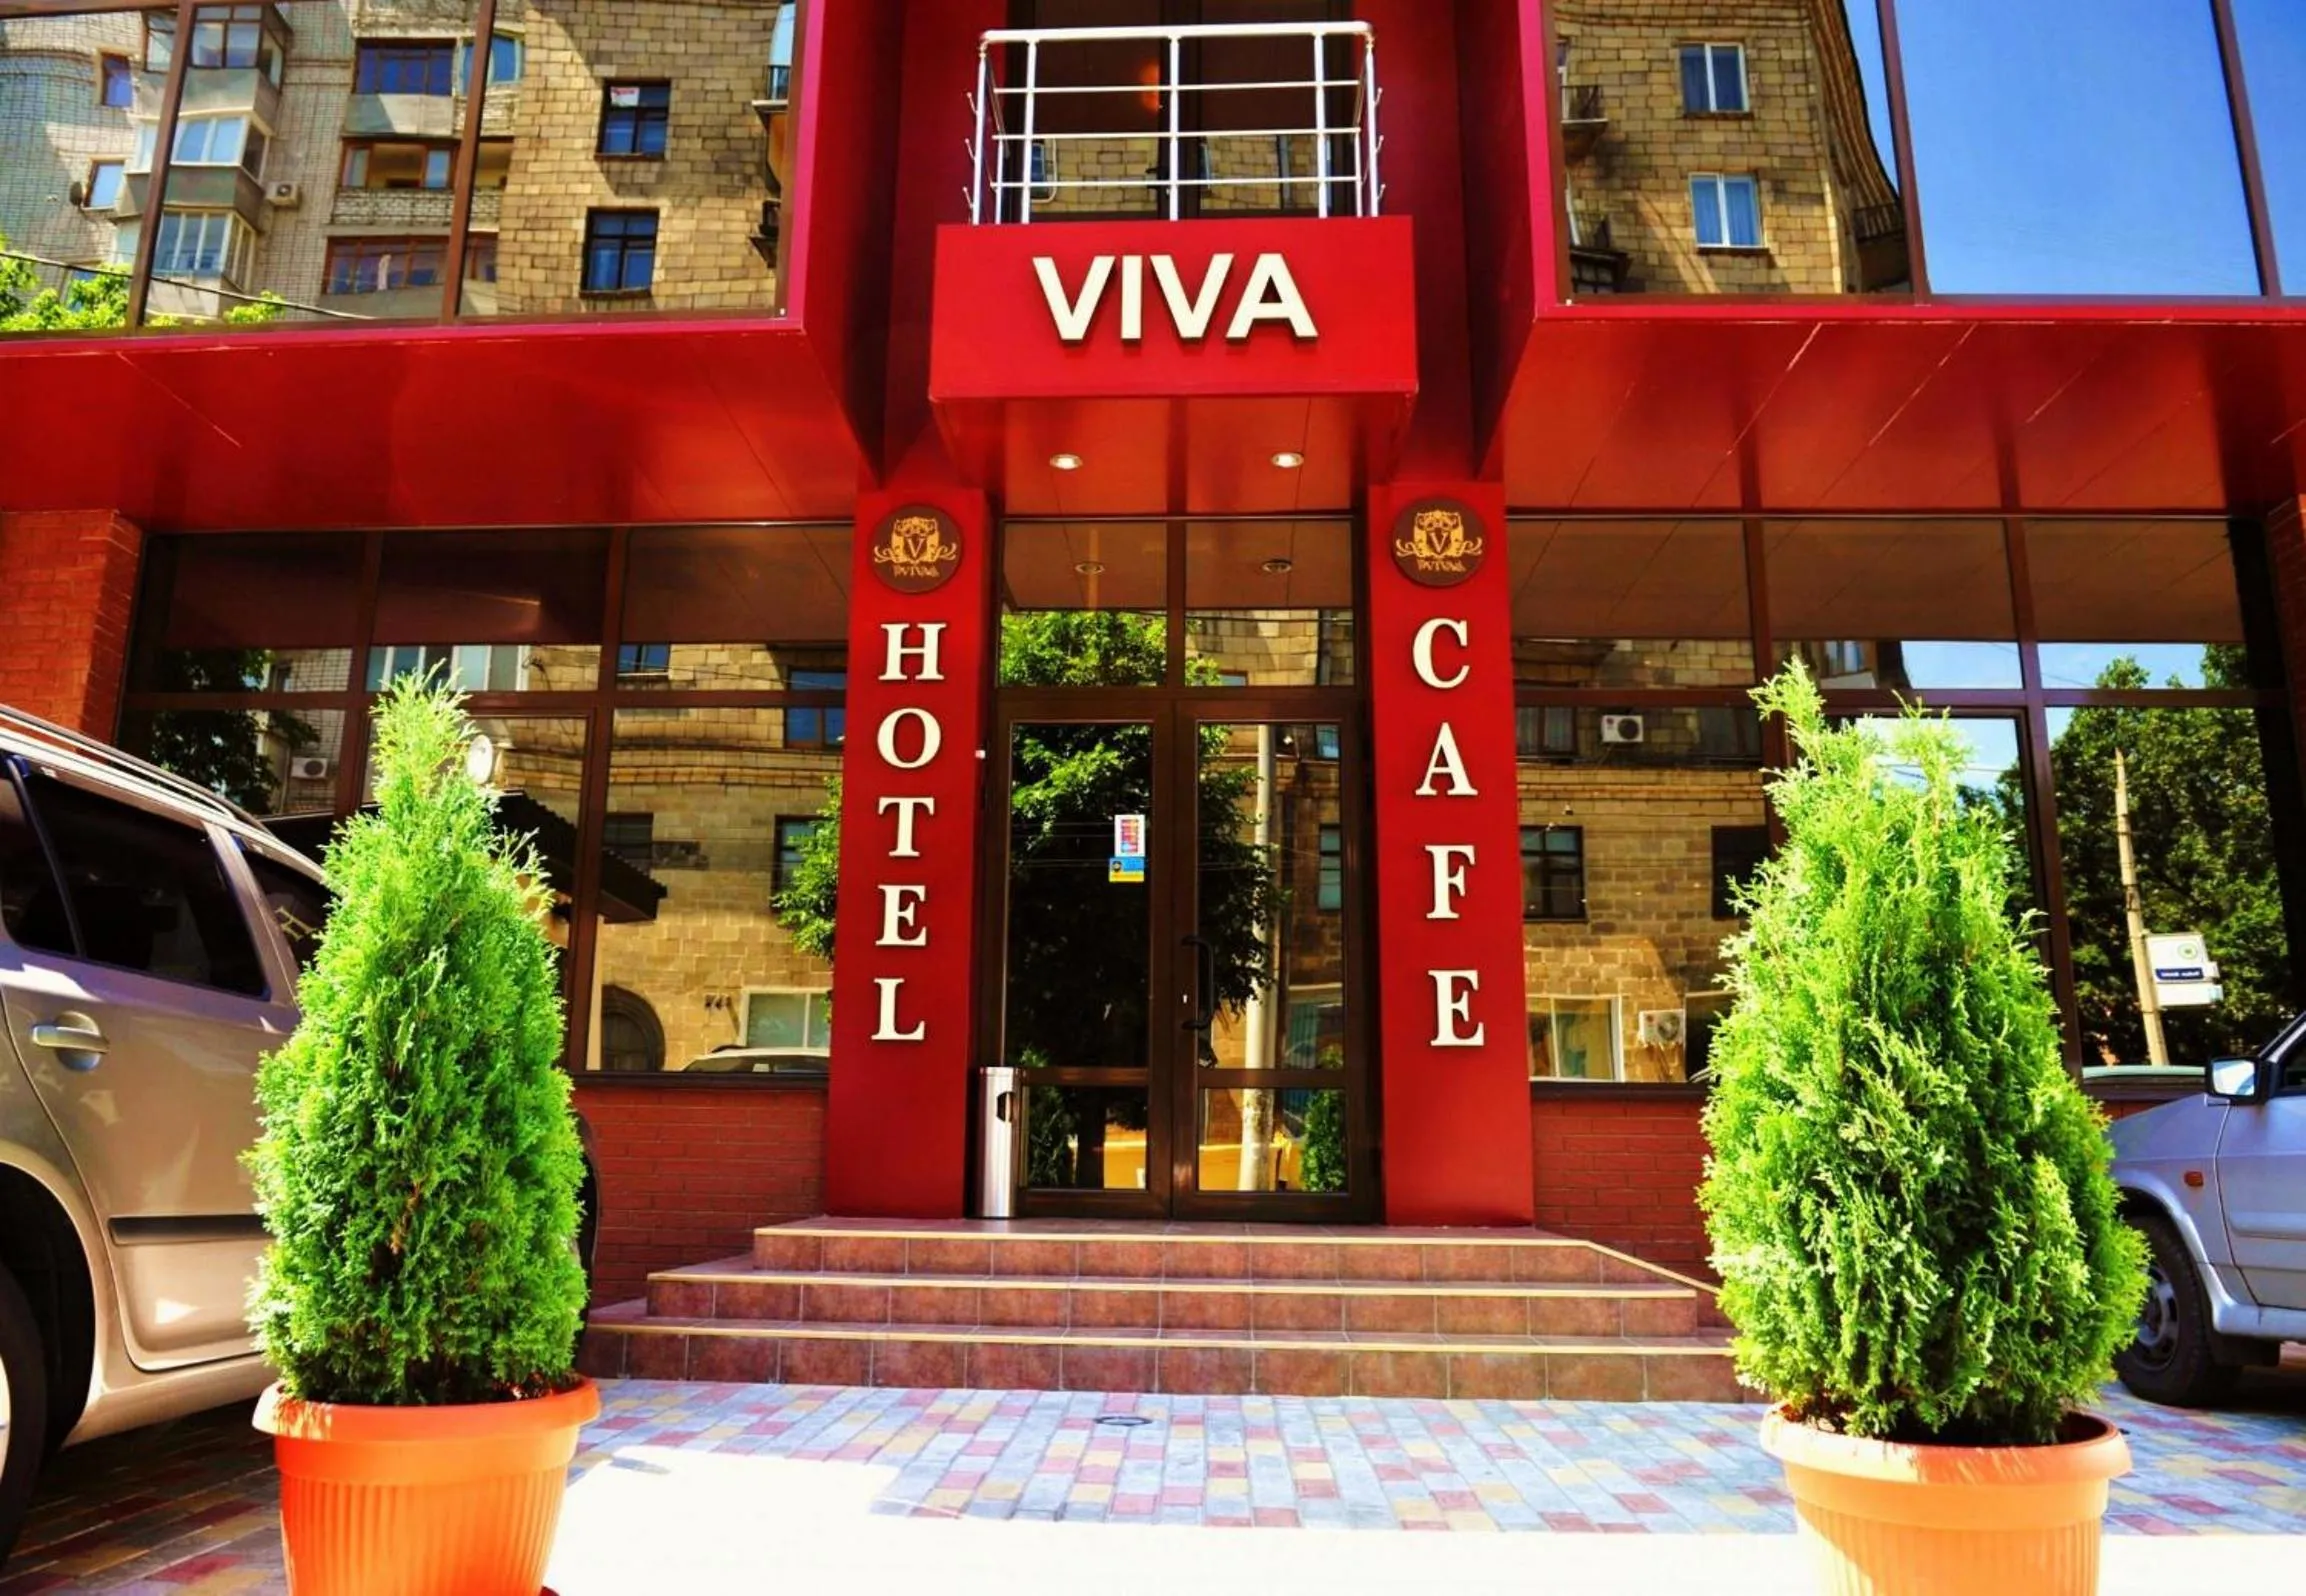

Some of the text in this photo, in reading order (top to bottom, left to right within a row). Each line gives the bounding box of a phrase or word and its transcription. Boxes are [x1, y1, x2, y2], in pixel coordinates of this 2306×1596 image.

[1032, 253, 1318, 342] VIVA
[906, 538, 925, 558] V
[1429, 532, 1448, 553] V
[871, 623, 947, 1042] HOTEL
[1412, 618, 1484, 1047] CAFE
